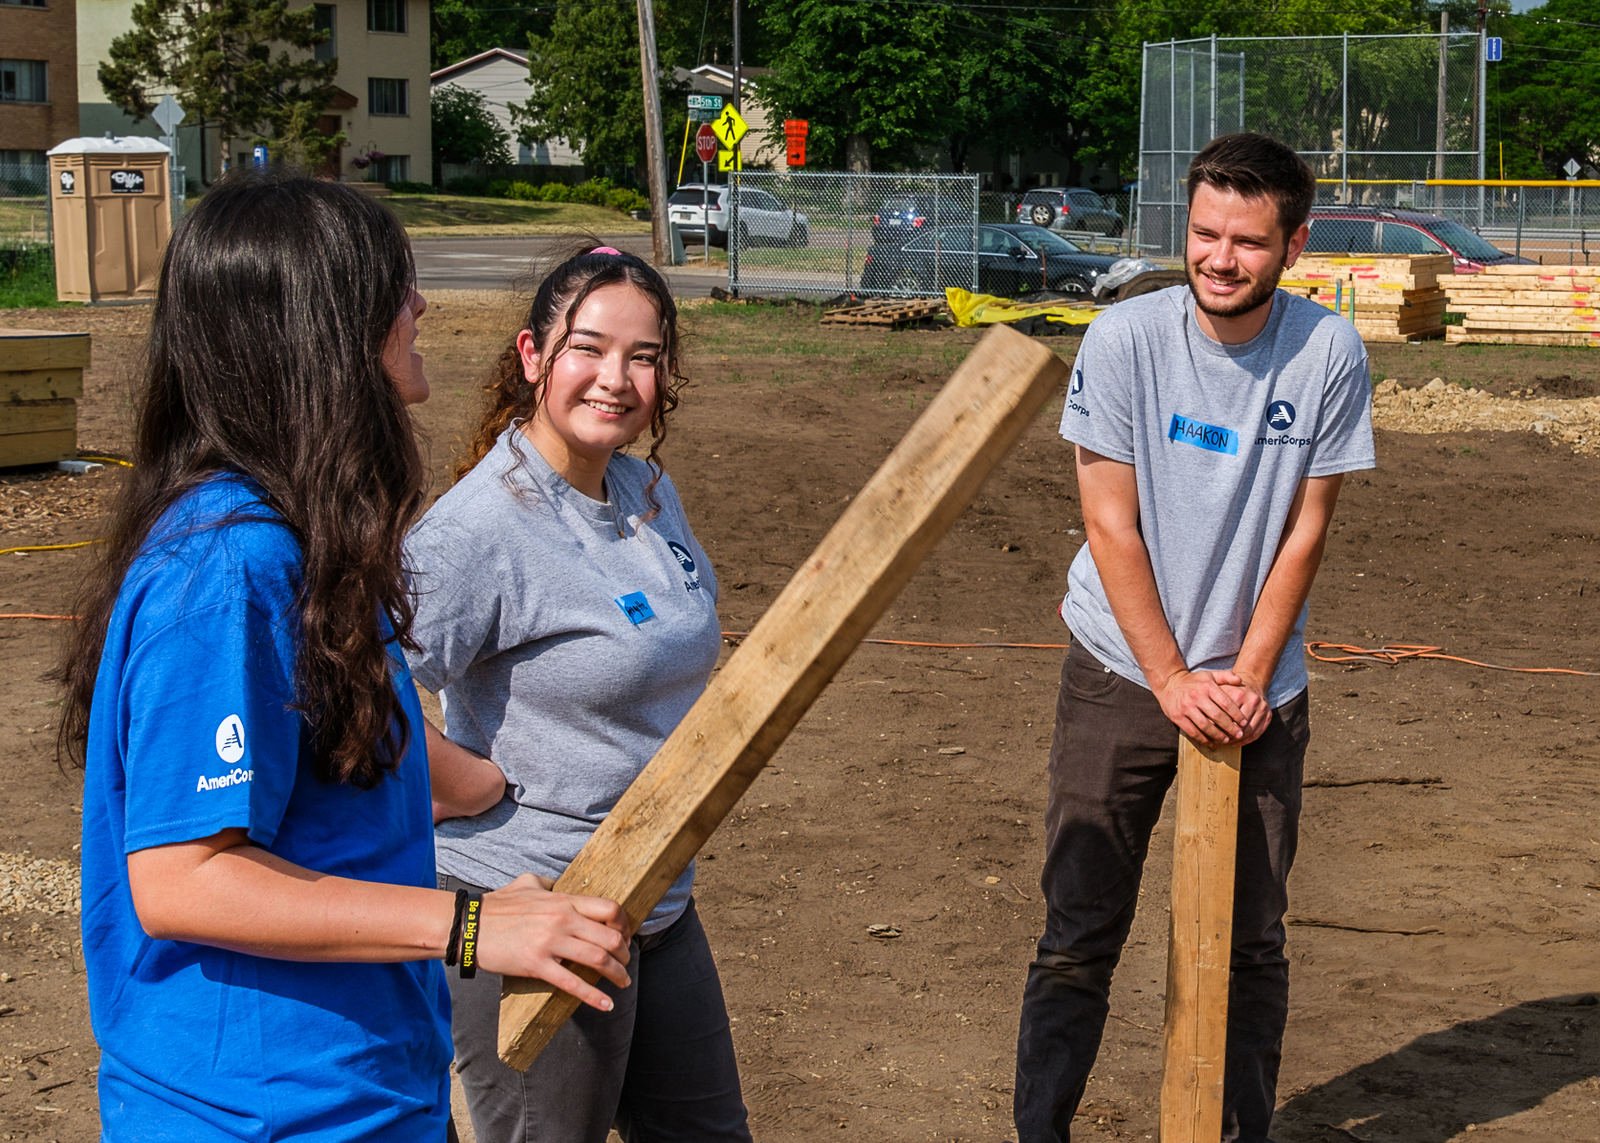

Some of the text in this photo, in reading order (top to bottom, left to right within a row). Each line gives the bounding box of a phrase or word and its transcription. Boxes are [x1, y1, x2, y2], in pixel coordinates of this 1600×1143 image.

[698, 136, 716, 151] STOP
[1174, 419, 1229, 449] HAAKON
[469, 901, 480, 912] Be
[464, 922, 477, 939] big
[463, 942, 475, 967] bitch
